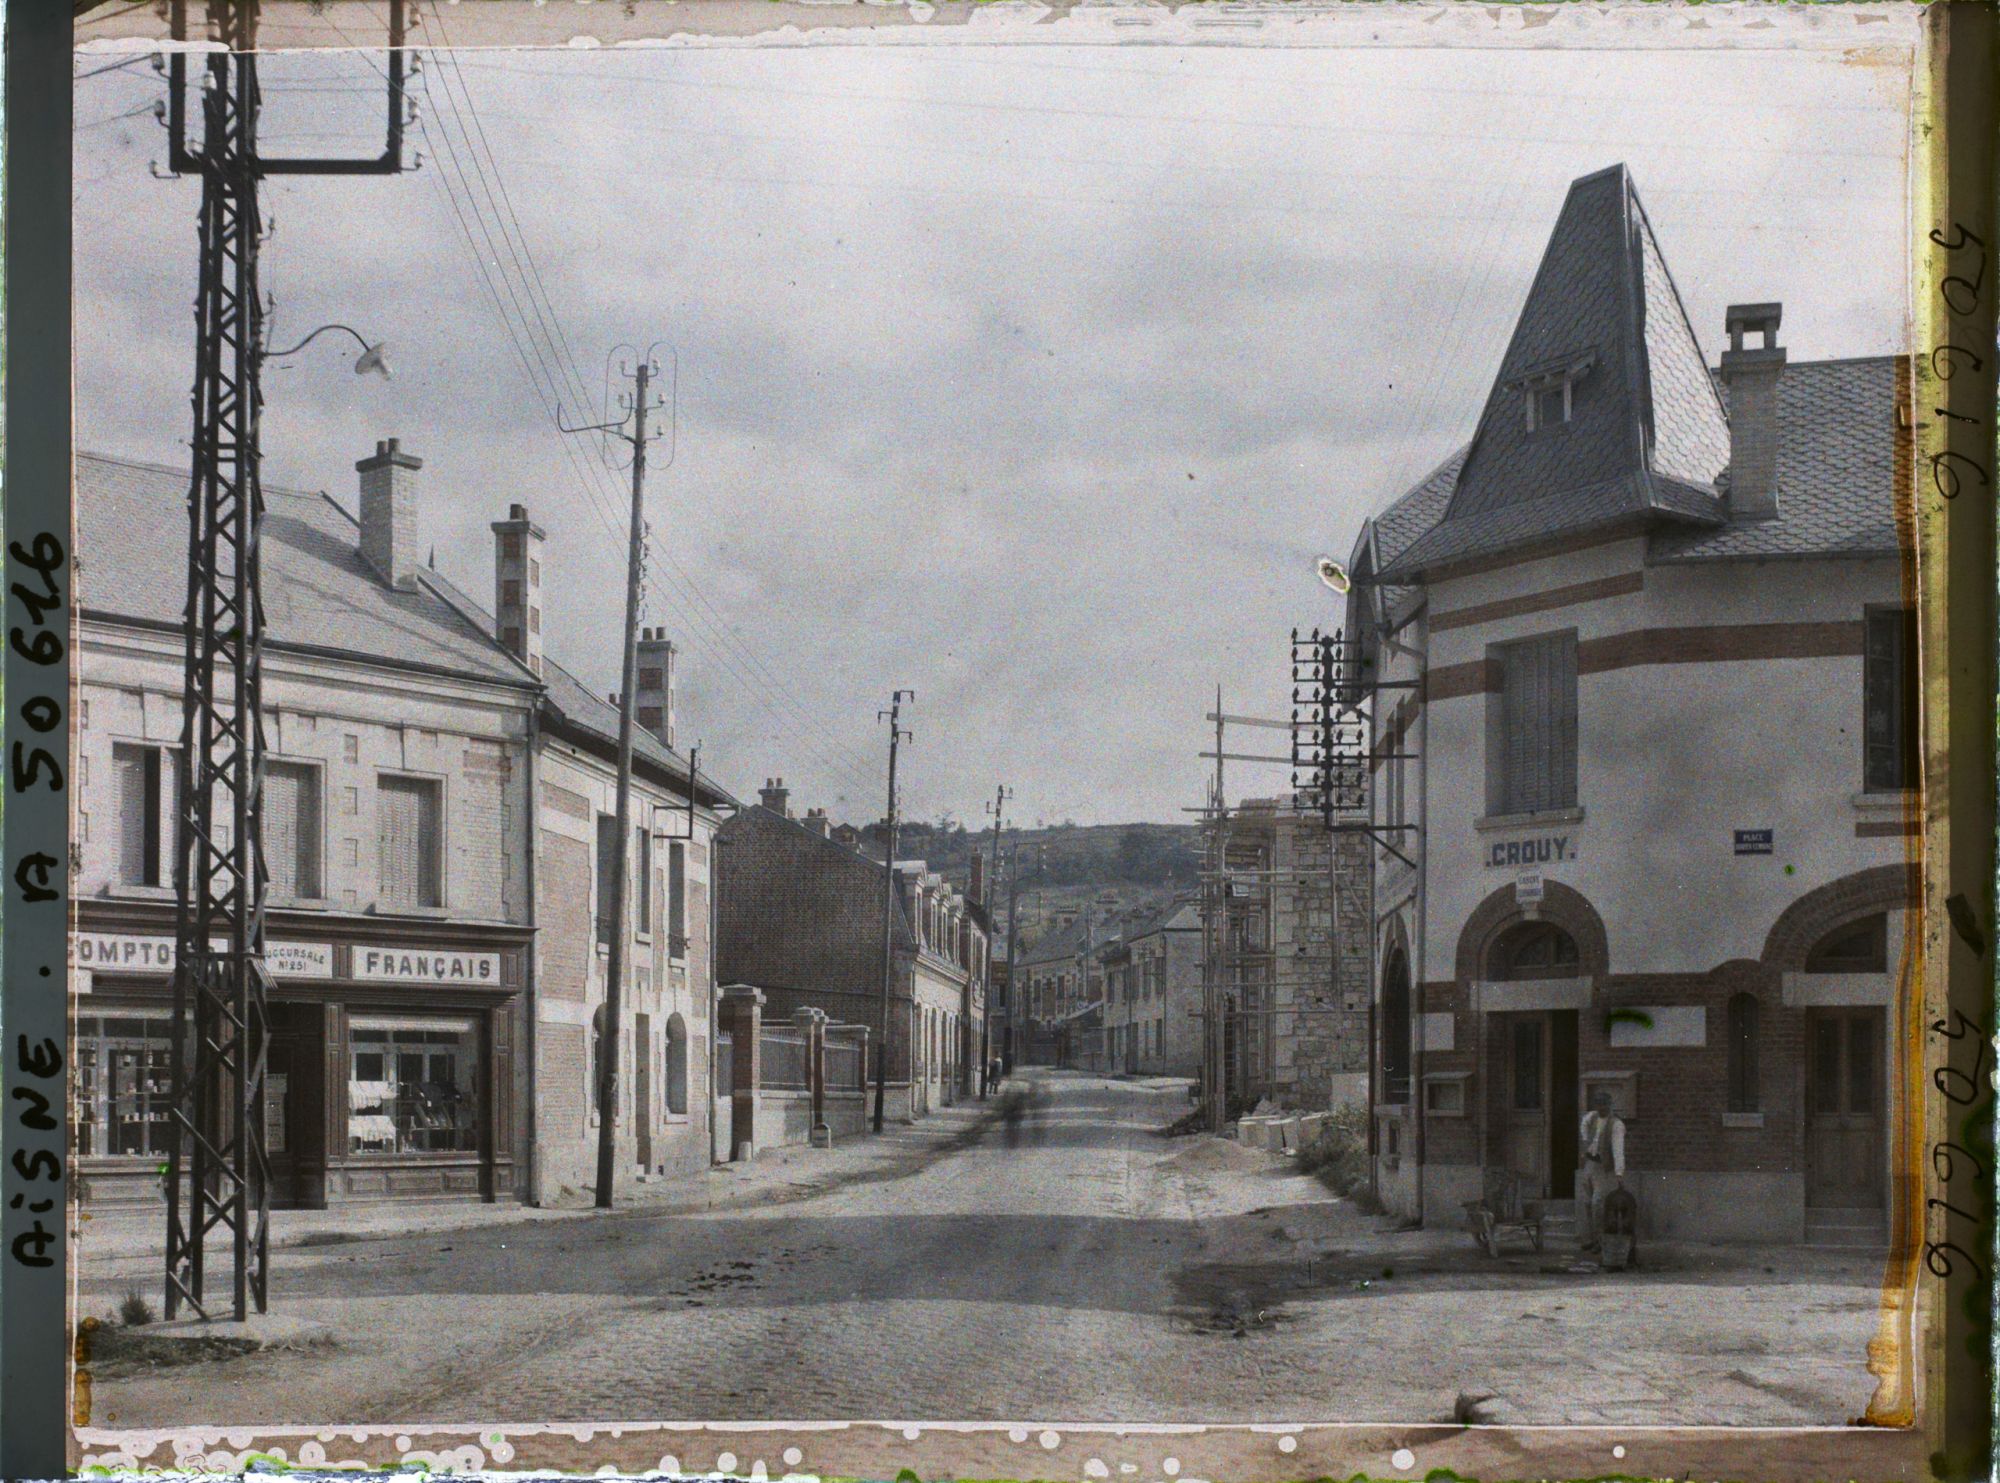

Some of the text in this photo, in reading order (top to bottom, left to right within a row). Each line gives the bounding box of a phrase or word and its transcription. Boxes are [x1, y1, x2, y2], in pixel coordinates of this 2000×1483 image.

[14, 851, 60, 903] A
[264, 948, 325, 965] UCCURSALE
[366, 951, 490, 978] FRANÇAIS
